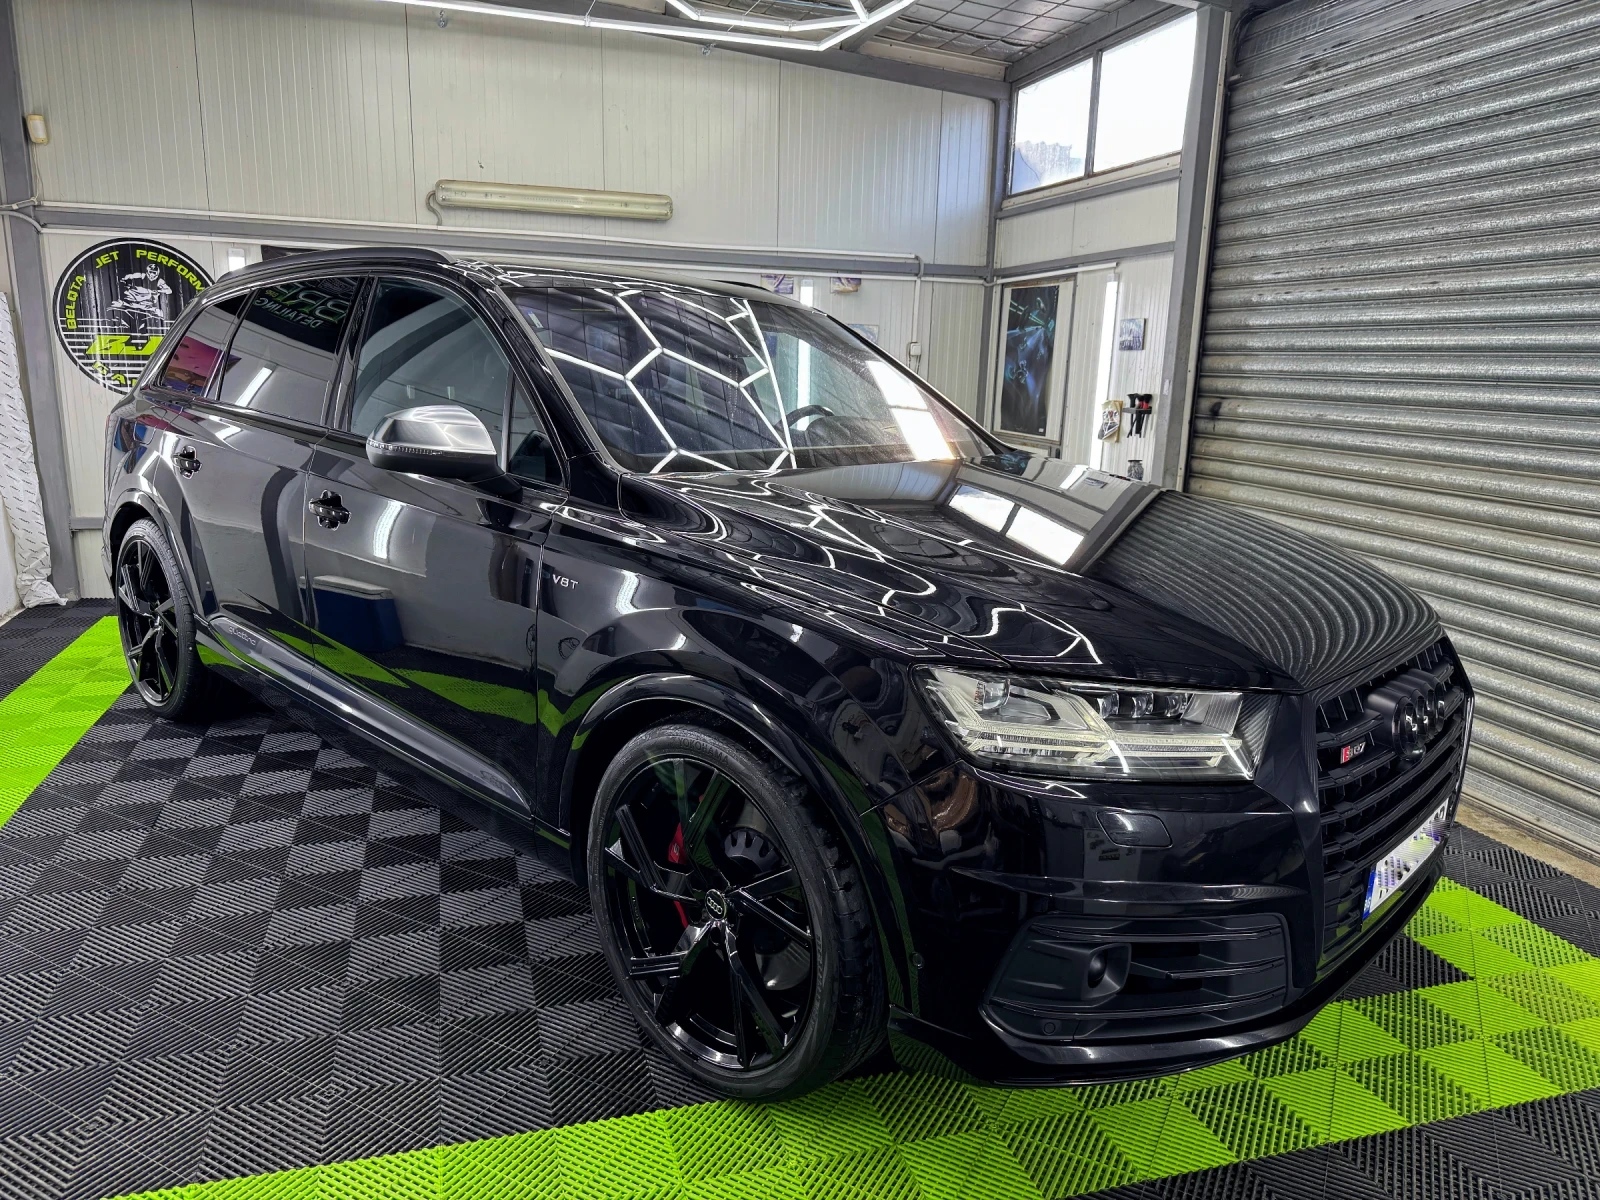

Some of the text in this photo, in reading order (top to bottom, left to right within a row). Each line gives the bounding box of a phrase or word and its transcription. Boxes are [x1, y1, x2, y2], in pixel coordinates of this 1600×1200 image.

[65, 275, 87, 329] BELQTA
[95, 250, 119, 269] JET
[552, 573, 579, 589] V8T
[679, 737, 729, 765] YOKOHAMA
